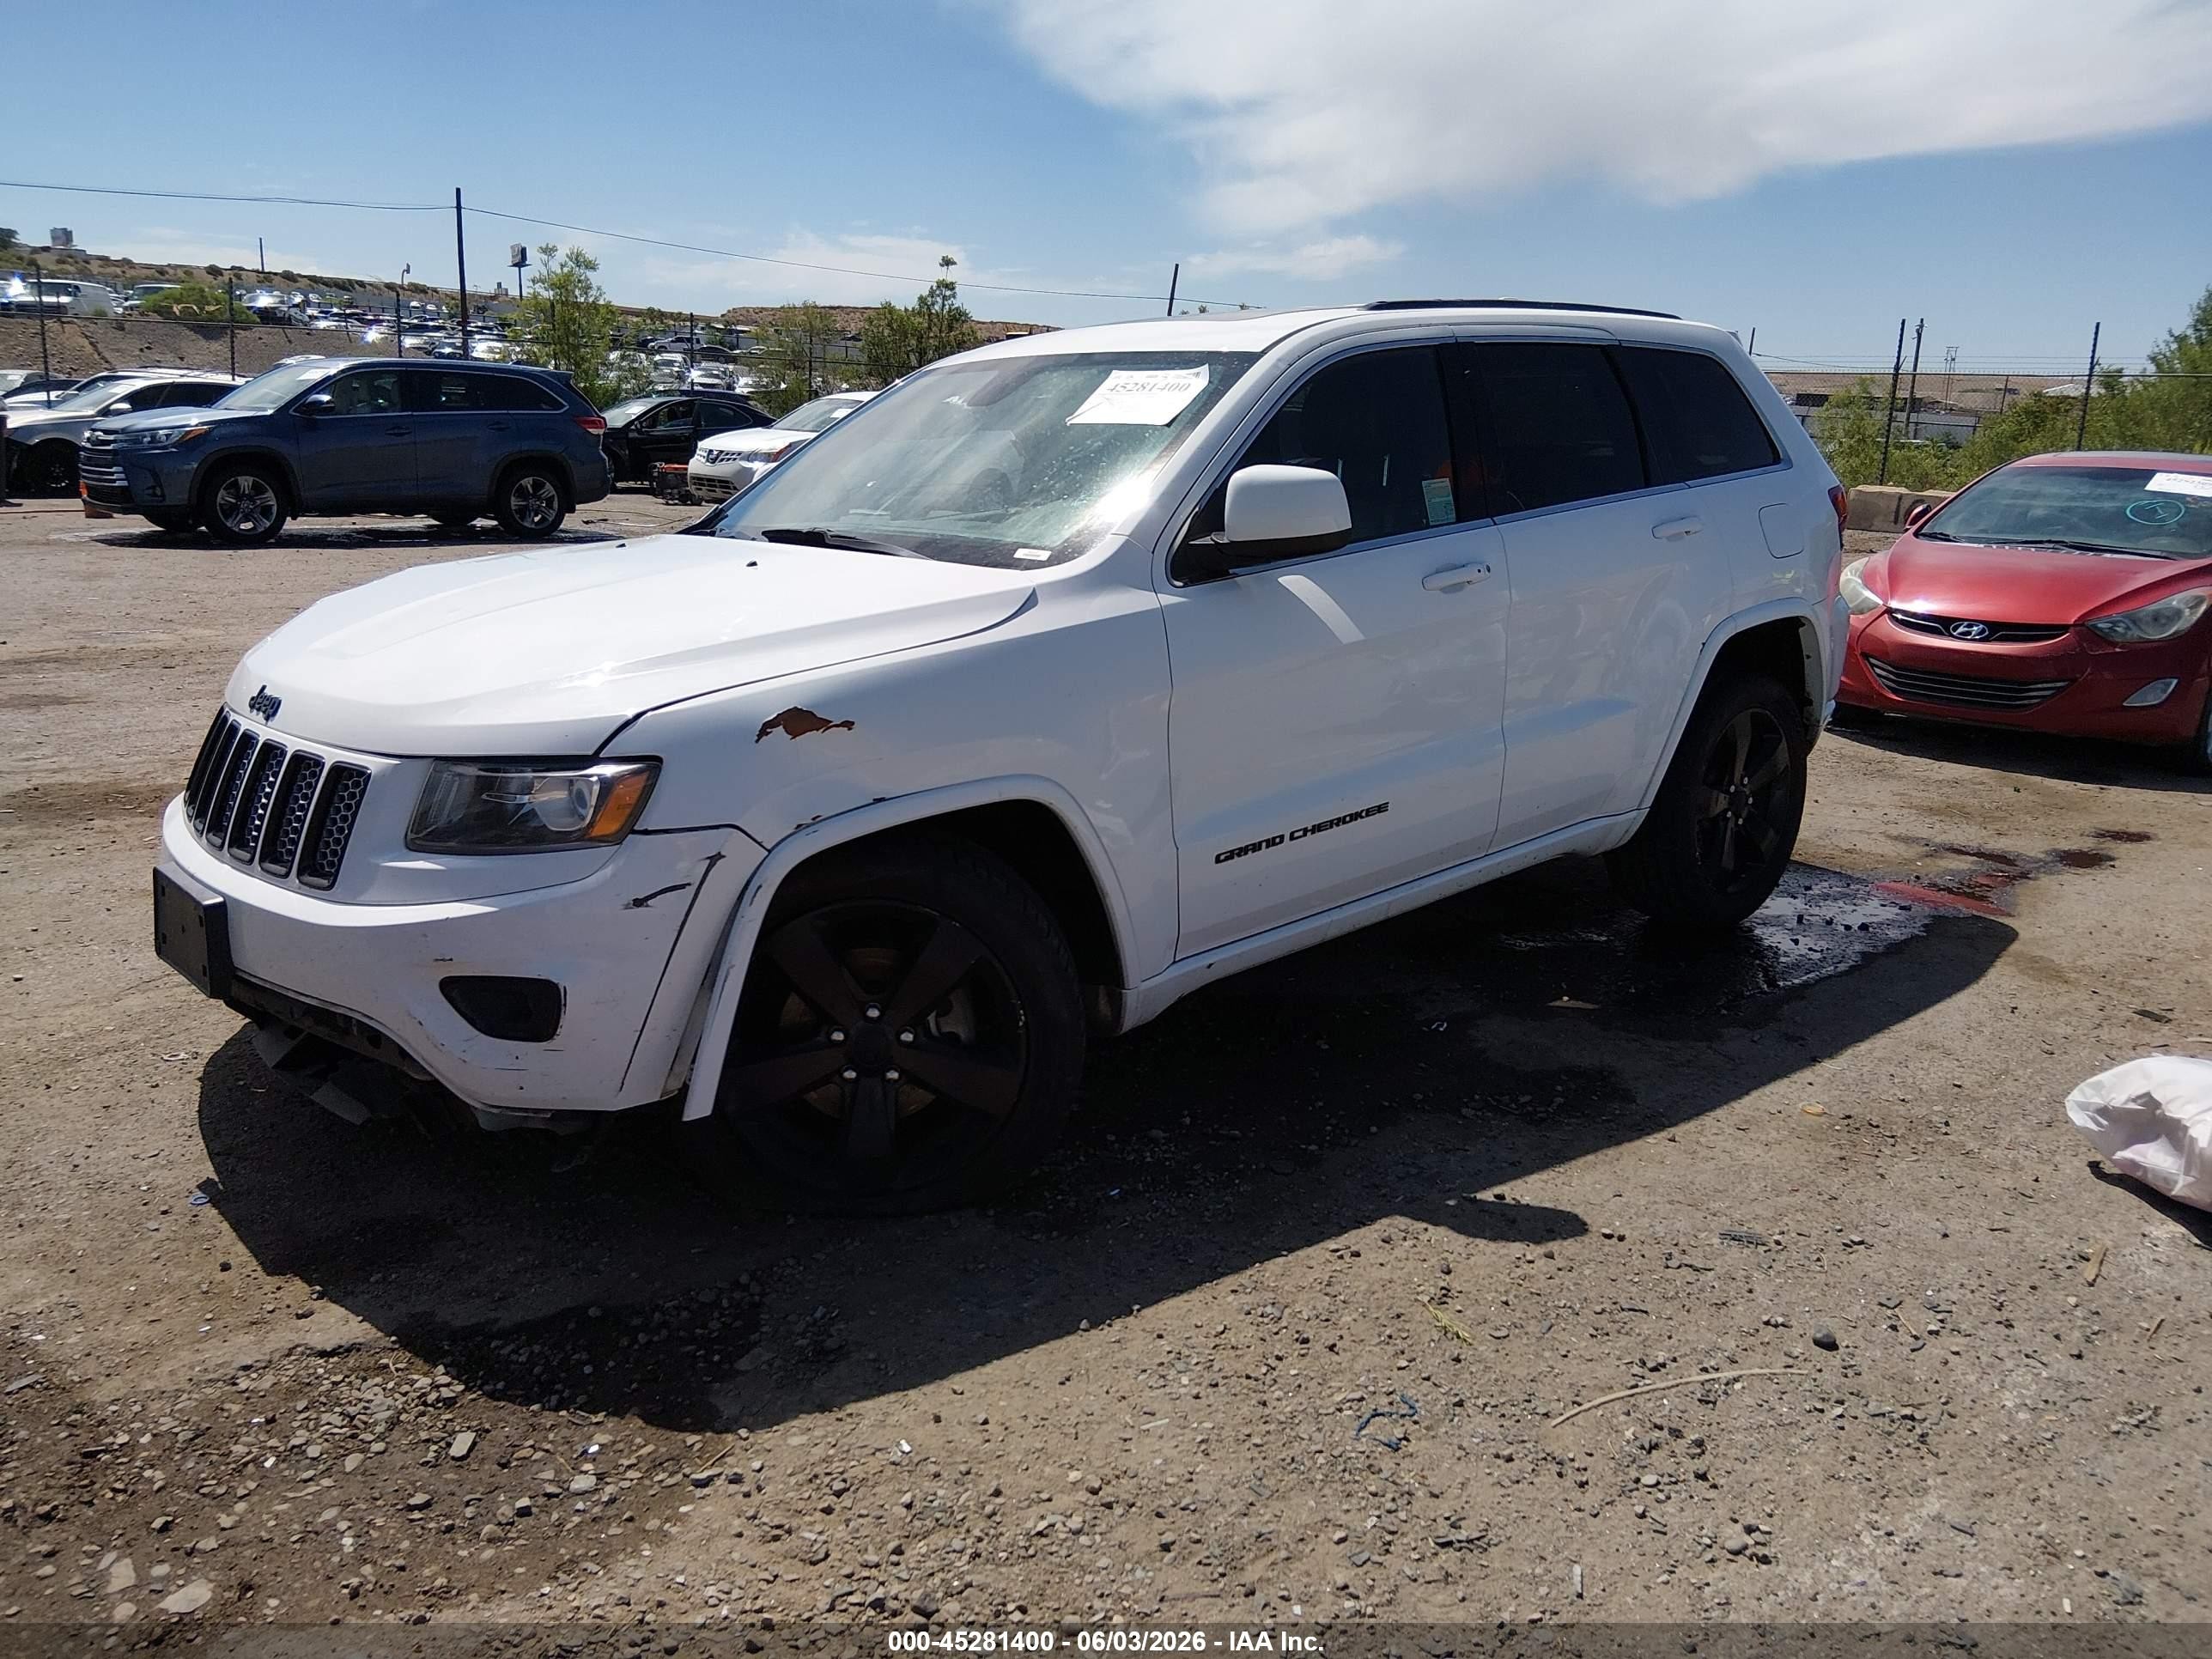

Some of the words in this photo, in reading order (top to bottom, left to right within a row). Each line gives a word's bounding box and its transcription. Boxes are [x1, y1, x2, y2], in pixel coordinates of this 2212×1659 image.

[1107, 381, 1191, 393] 45281400
[248, 684, 283, 723] Jeep
[1215, 834, 1285, 865] GRAND
[1289, 802, 1390, 842] CHEROKEE
